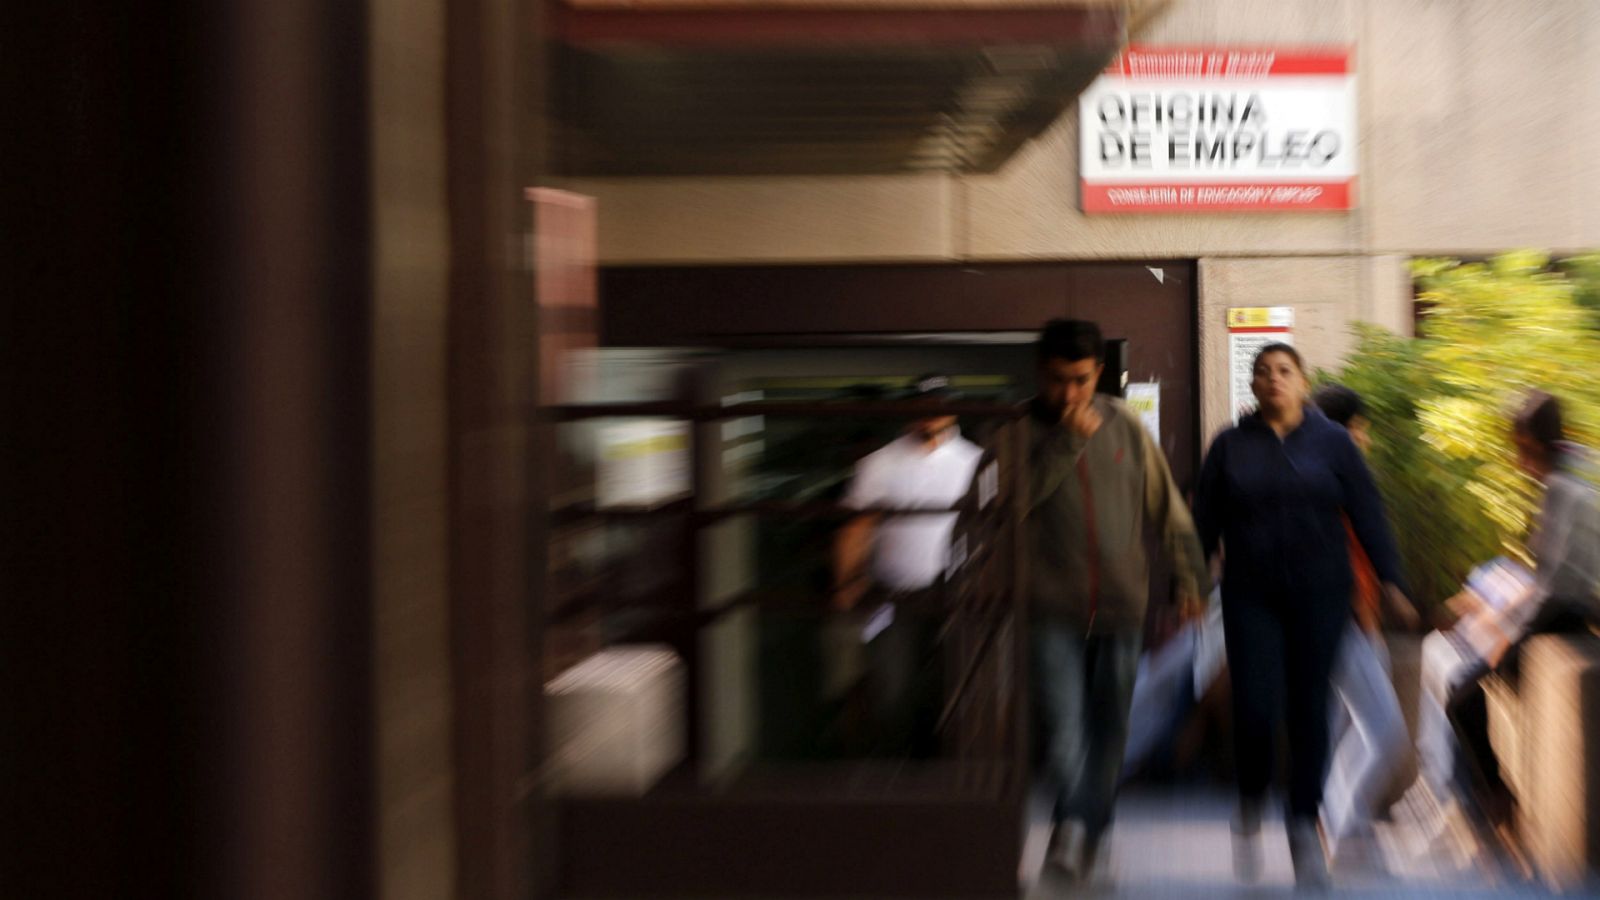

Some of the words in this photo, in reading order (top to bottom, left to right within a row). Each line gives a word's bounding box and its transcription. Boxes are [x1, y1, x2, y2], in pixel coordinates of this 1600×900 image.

[1129, 52, 1203, 78] Comunidad
[1207, 52, 1221, 78] de
[1225, 52, 1275, 78] Madrid
[1098, 91, 1266, 130] OFICINA
[1100, 130, 1152, 168] DE
[1168, 130, 1340, 168] EMPLEO
[1108, 187, 1177, 205] CONSEJERÍA
[1180, 187, 1194, 204] DE
[1197, 186, 1263, 204] EDUCACIÓN
